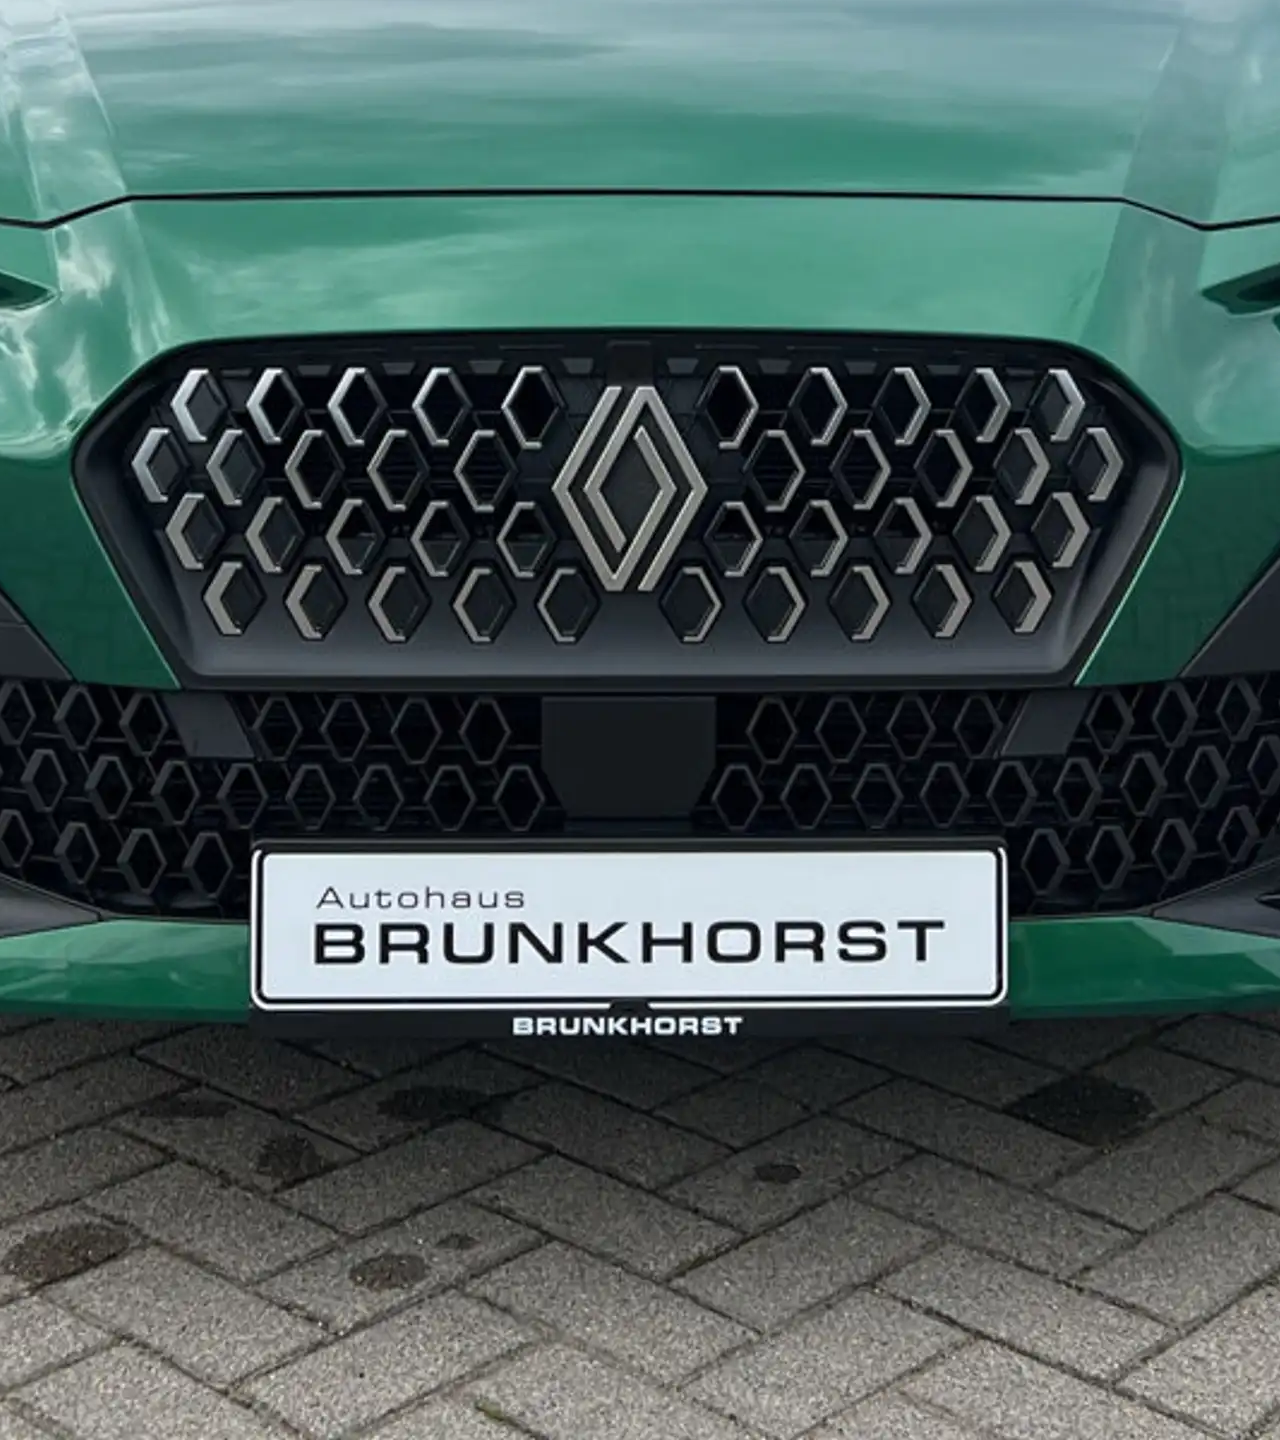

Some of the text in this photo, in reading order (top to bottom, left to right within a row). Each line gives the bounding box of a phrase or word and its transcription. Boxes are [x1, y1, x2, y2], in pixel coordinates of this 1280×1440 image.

[316, 886, 525, 909] Autohaus
[314, 921, 945, 964] BRUNKHORST
[512, 1016, 743, 1036] BRUNKHORST
